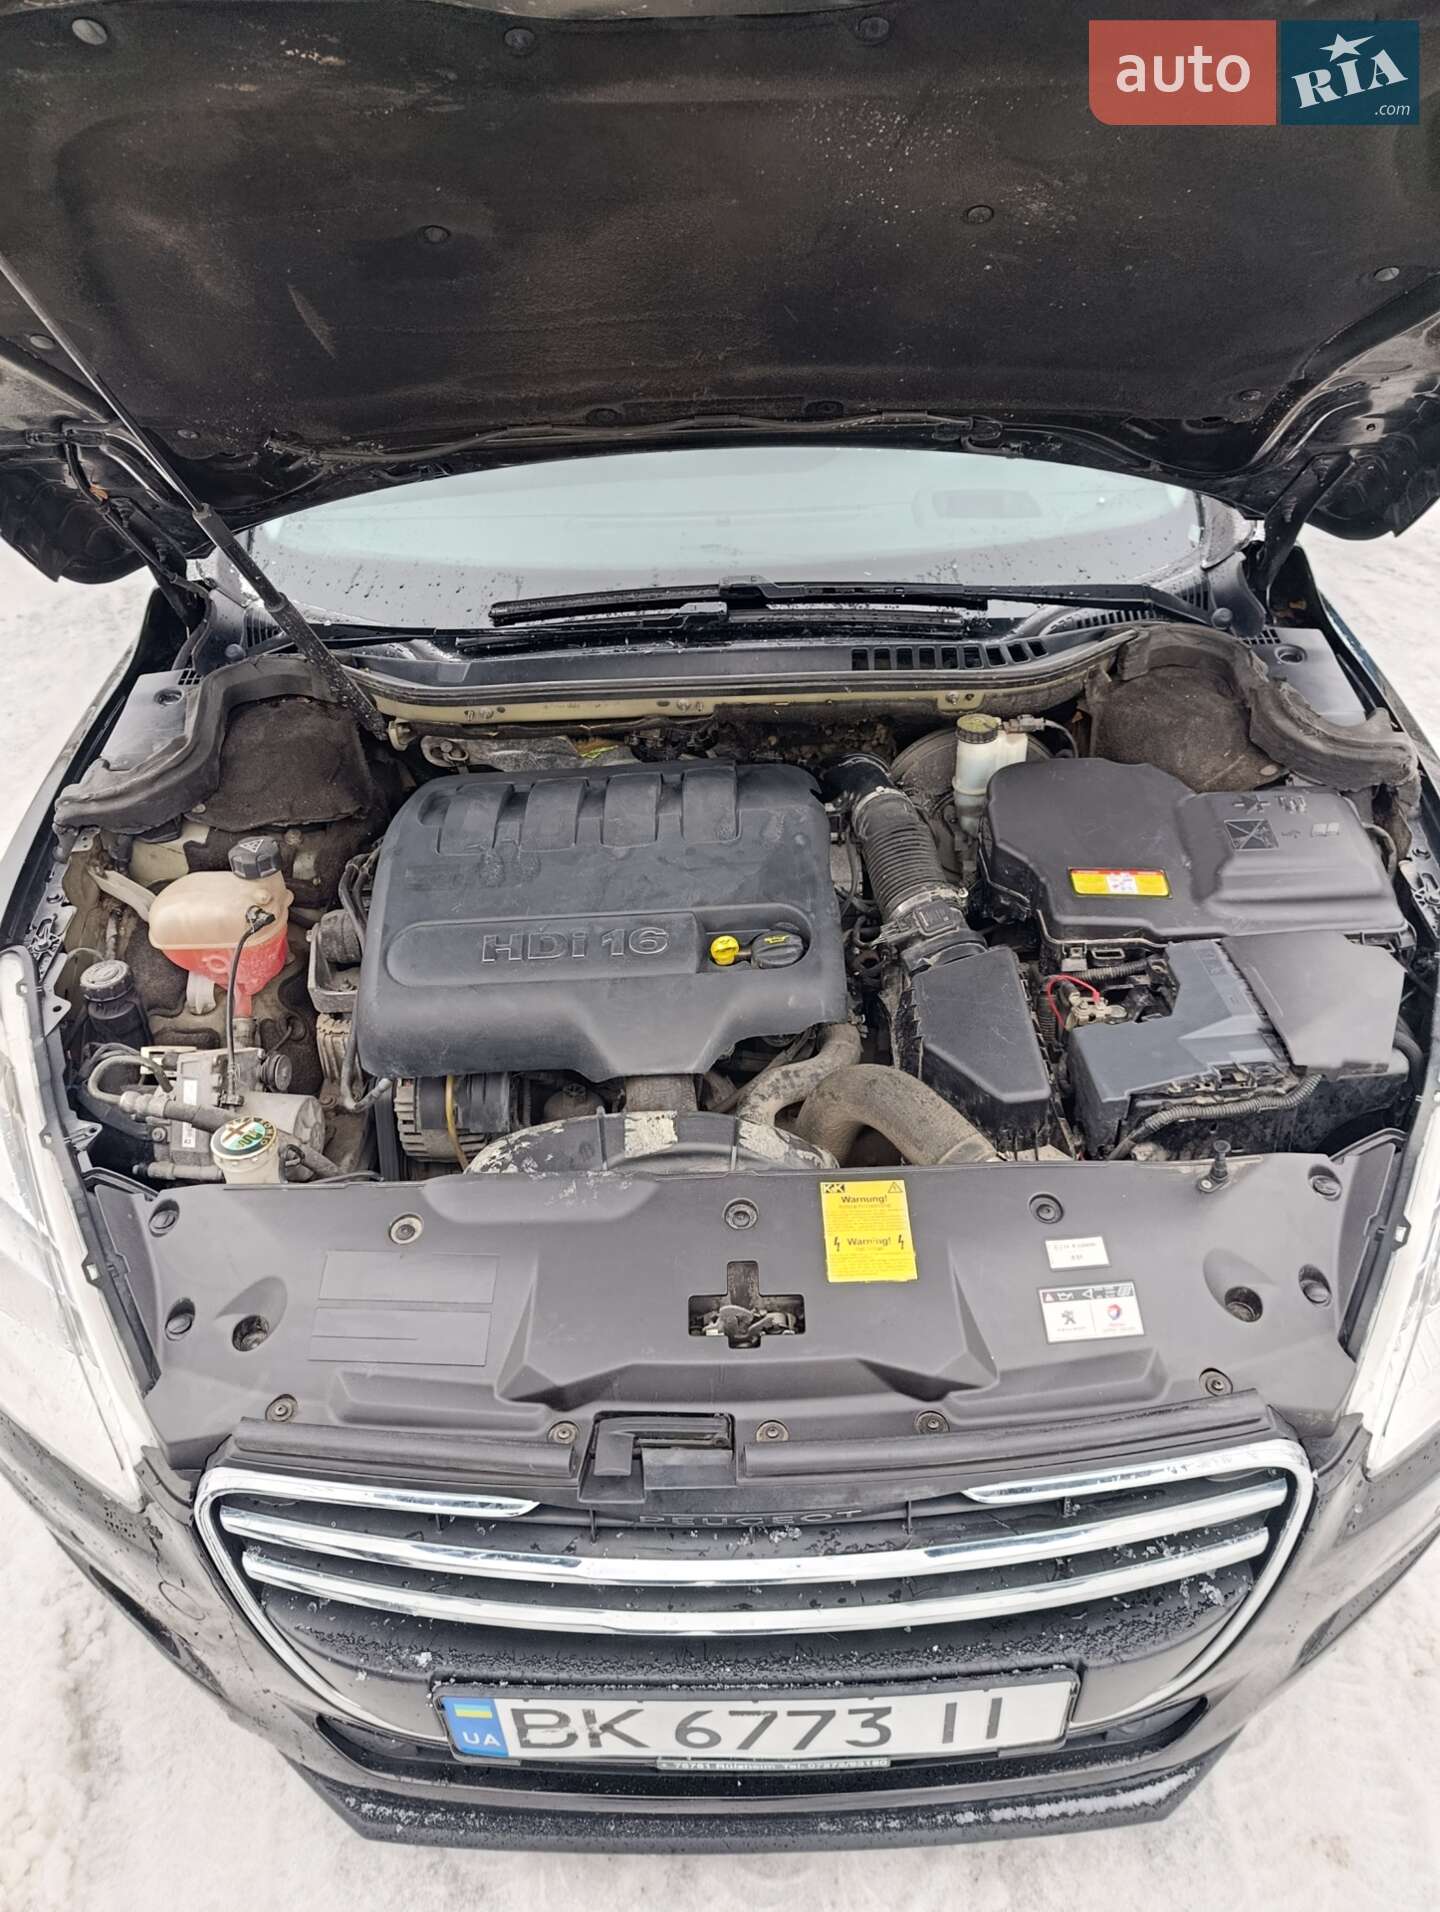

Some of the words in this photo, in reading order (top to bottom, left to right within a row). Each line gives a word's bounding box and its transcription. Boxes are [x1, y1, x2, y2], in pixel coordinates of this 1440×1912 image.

[601, 926, 672, 956] 16
[841, 1195, 888, 1204] Warnung!
[847, 1237, 892, 1247] Warning!
[639, 1509, 863, 1528] PEUGEOT
[510, 1708, 651, 1749] BK
[674, 1706, 892, 1750] 6773
[462, 1731, 501, 1747] UA
